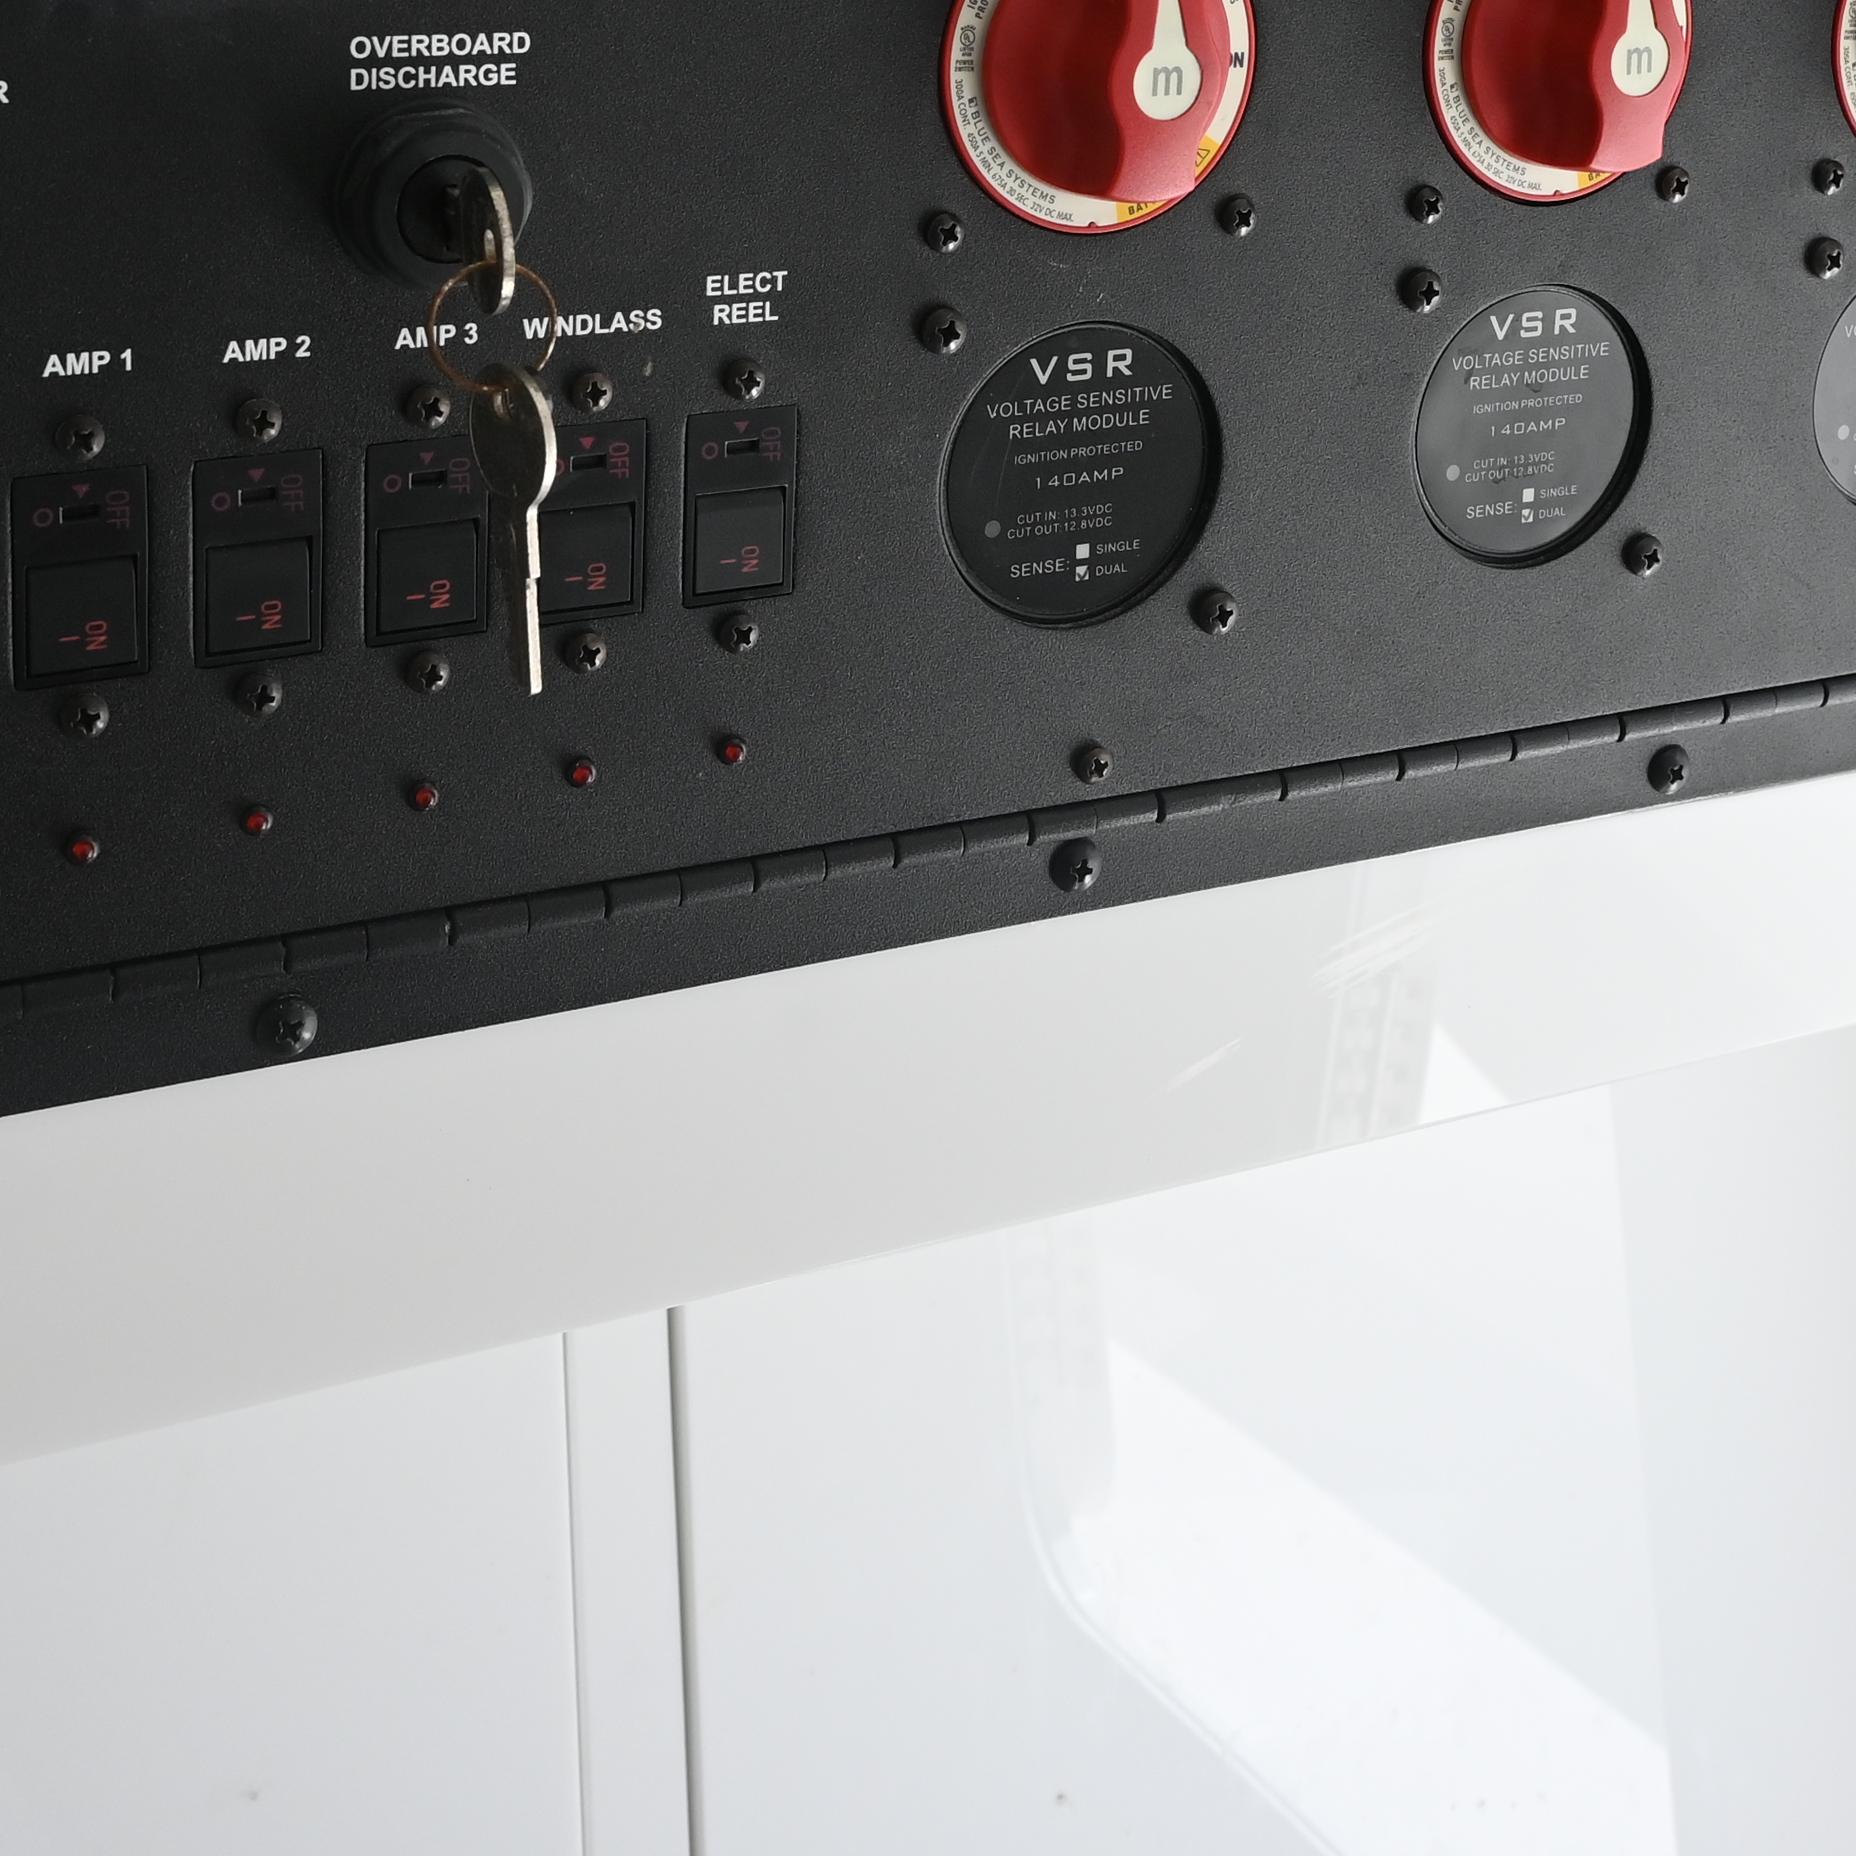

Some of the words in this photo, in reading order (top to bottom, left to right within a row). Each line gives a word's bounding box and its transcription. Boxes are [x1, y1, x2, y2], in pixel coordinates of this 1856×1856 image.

[350, 32, 530, 59] OVERBOARD
[350, 63, 516, 90] DISCHARGE
[970, 110, 991, 146] BLUE
[986, 145, 1006, 172] SEA
[1004, 168, 1056, 205] SYSTEMS
[706, 271, 788, 296] ELECT
[522, 308, 663, 340] WNDLASS
[713, 301, 779, 325] REEL
[1490, 308, 1577, 340] VSR
[222, 337, 287, 363] AMP
[295, 335, 311, 357] 2
[394, 324, 456, 350] AMP
[464, 323, 478, 344] 3
[42, 351, 110, 377] AMP
[120, 348, 131, 371] 1
[1030, 347, 1133, 385] VSR
[1452, 351, 1523, 370] VOLTAGE
[1528, 342, 1610, 363] SENSITIVE
[1470, 372, 1520, 390] RELAY
[1524, 365, 1589, 385] MODULE
[987, 396, 1071, 419] VOLTAGE
[1077, 384, 1173, 410] SENSITIVE
[1009, 420, 1068, 440] RELAY
[1073, 410, 1150, 432] MODULE
[1014, 449, 1068, 465] IGNITION
[1070, 440, 1143, 459] PROTECTED
[1017, 512, 1041, 525] CUT
[1063, 503, 1113, 518] 13.3VDC
[1007, 527, 1032, 540] CUT
[1063, 516, 1113, 531] 12.8VDC
[1096, 539, 1140, 554] SINGLE
[586, 562, 607, 592] ON
[1010, 559, 1070, 578] SENSE:
[1095, 563, 1127, 576] DUAL
[260, 600, 283, 632] ON
